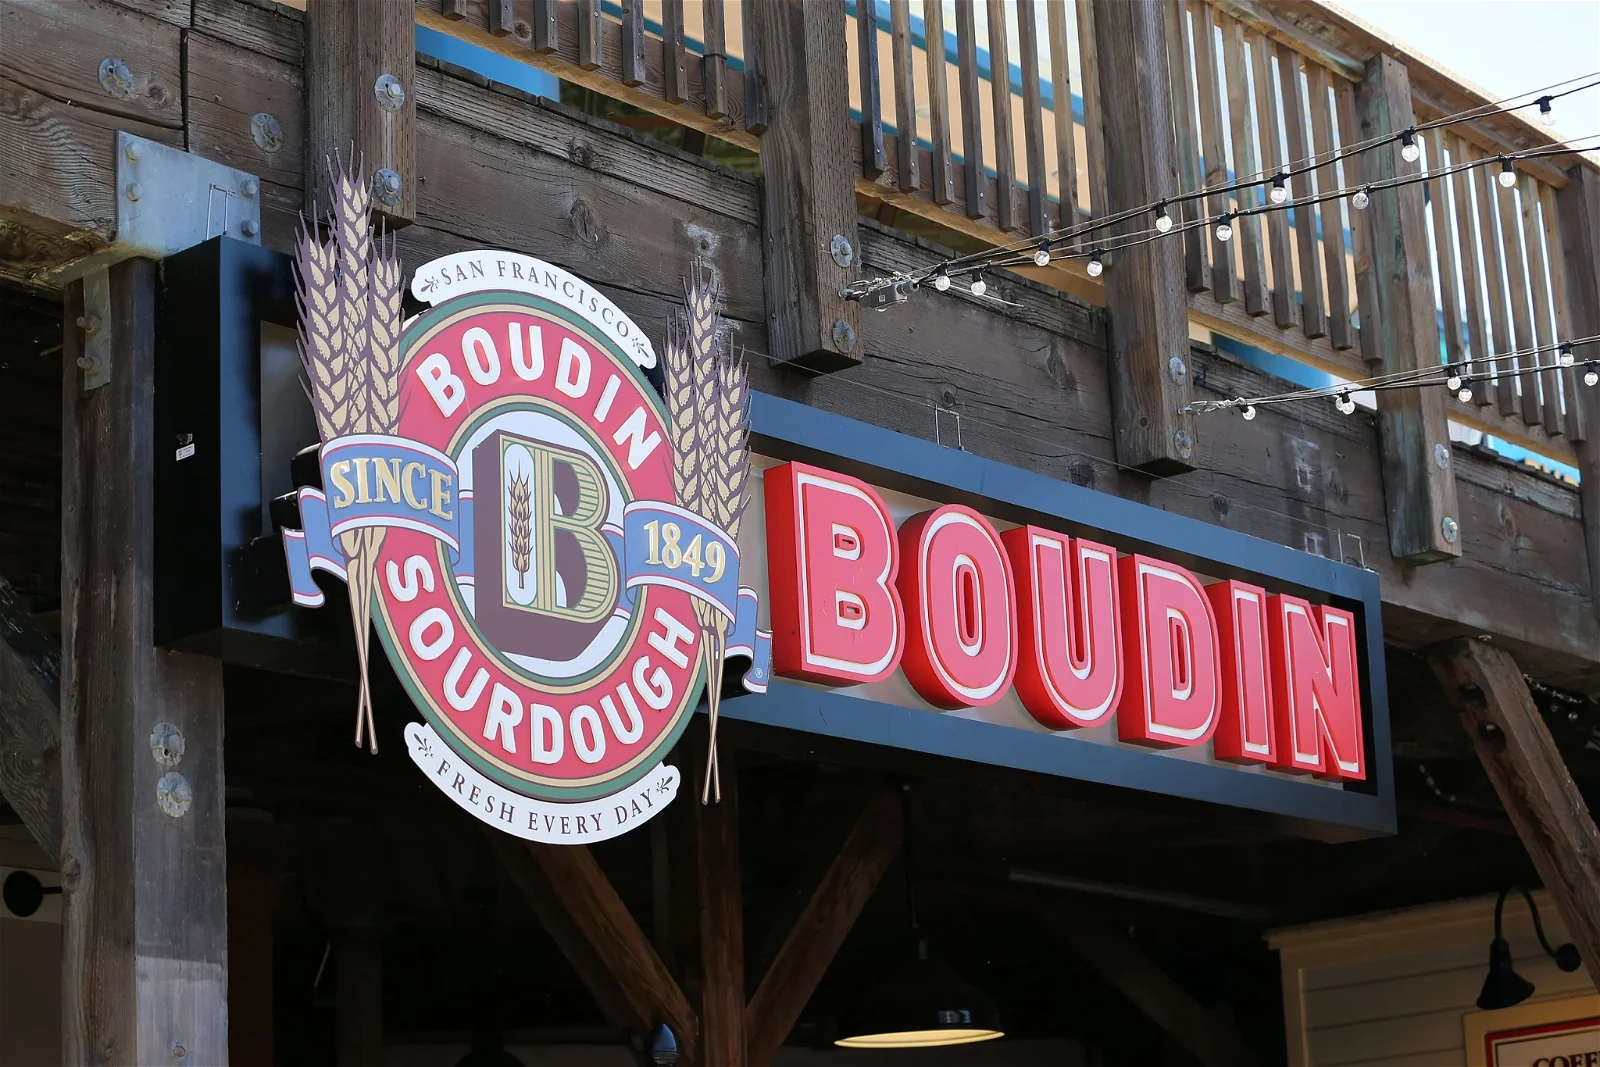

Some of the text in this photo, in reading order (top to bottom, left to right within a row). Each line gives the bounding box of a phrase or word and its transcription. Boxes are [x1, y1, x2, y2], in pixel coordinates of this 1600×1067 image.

[440, 260, 629, 339] SAN FRANCISCO
[415, 322, 661, 470] BOUDIN
[330, 457, 726, 583] SINCE 1849
[385, 555, 695, 765] SOURDOUGH
[764, 461, 1366, 781] BOUDIN
[436, 759, 655, 835] FRESH EVERY DAY
[1532, 1051, 1600, 1067] COFF
